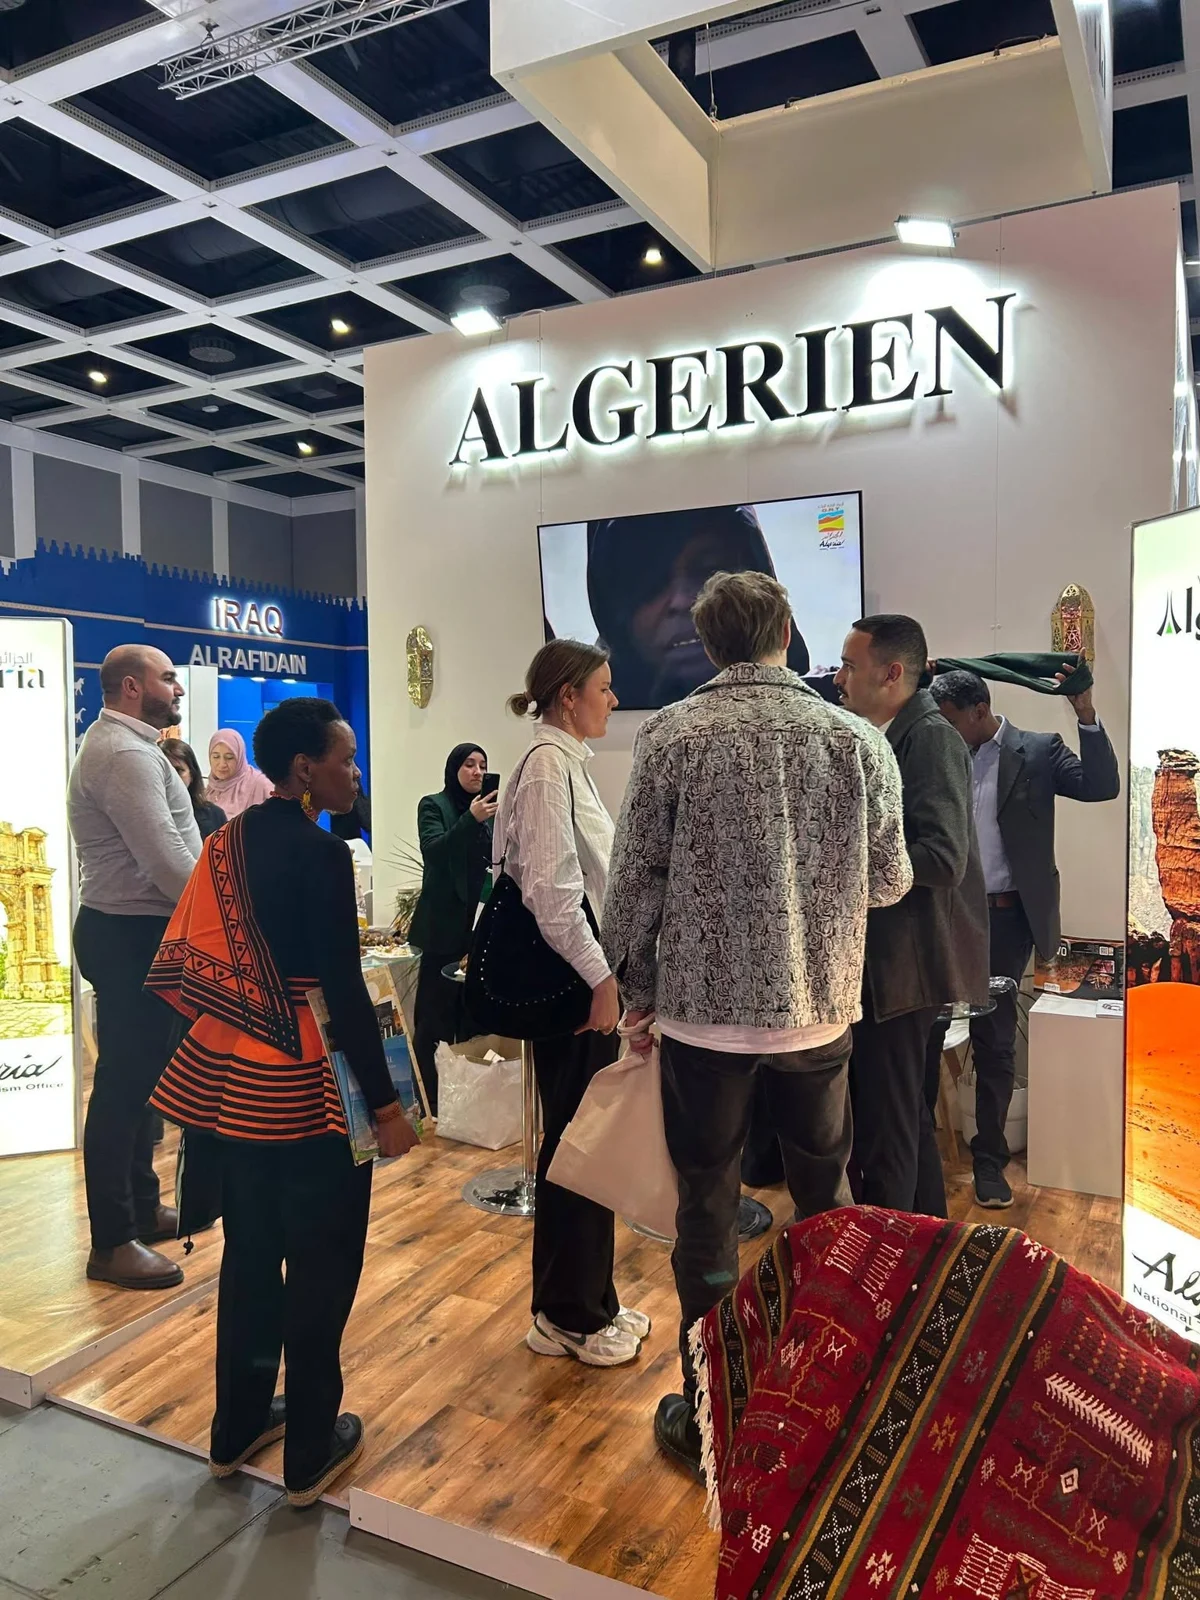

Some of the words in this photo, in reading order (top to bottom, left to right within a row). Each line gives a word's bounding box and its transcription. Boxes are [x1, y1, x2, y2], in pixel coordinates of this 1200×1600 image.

[448, 293, 1017, 466] ALGERIEN
[214, 598, 284, 636] IRAQ
[1157, 587, 1200, 641] Al
[189, 644, 307, 675] ALRAFIDAIN
[1133, 1284, 1191, 1325] National
